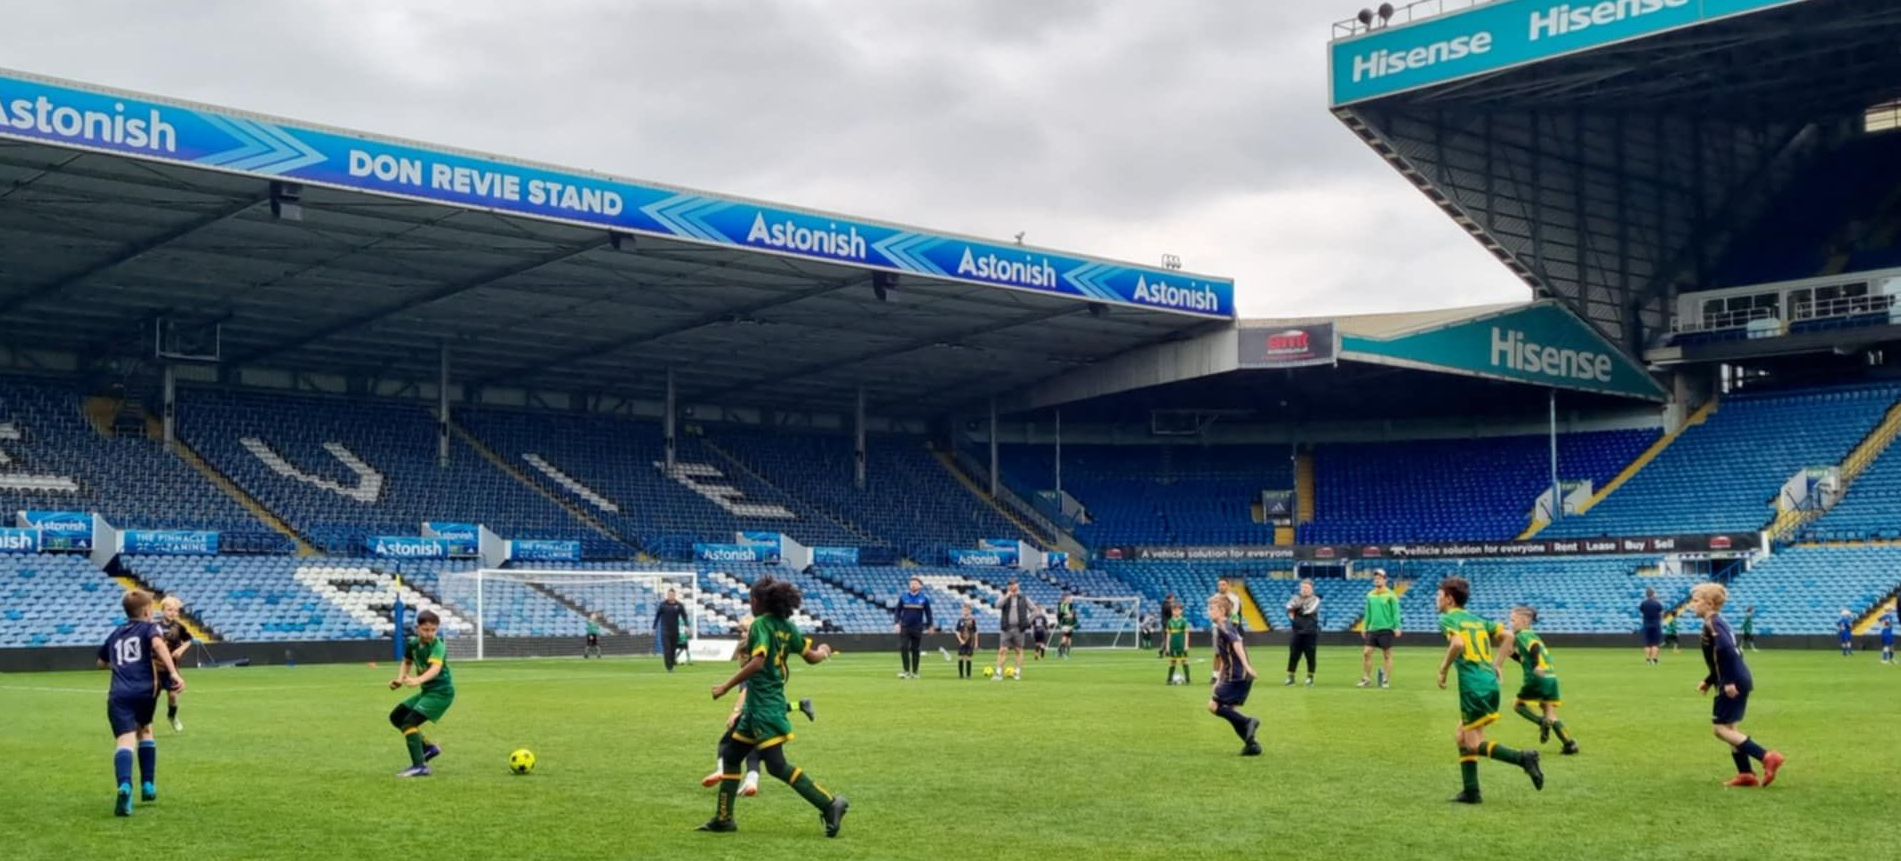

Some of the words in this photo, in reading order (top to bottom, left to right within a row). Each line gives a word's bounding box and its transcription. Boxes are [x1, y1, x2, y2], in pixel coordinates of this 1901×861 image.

[1352, 31, 1492, 83] Hisense
[349, 150, 422, 186] DON
[432, 163, 520, 201] REVIE
[528, 179, 623, 216] STAND
[747, 211, 866, 259] Astonish
[957, 246, 1056, 288] Astonish
[1133, 273, 1219, 311] Astonish
[1491, 326, 1612, 382] Hisense
[375, 539, 442, 556] Astonish
[703, 549, 756, 561] Astonish
[958, 554, 1000, 565] Astonish
[1141, 549, 1150, 558] A
[1152, 549, 1185, 559] vehicle
[1187, 549, 1228, 559] solution
[1230, 549, 1245, 558] for
[1247, 549, 1294, 560] everyone
[1442, 545, 1482, 555] solution
[1484, 544, 1499, 554] for
[1500, 544, 1545, 555] everyone
[1554, 542, 1578, 551] Rent
[1586, 541, 1616, 551] Lease
[1624, 540, 1646, 551] Buy
[1654, 539, 1675, 549] Sell
[114, 636, 142, 666] 10
